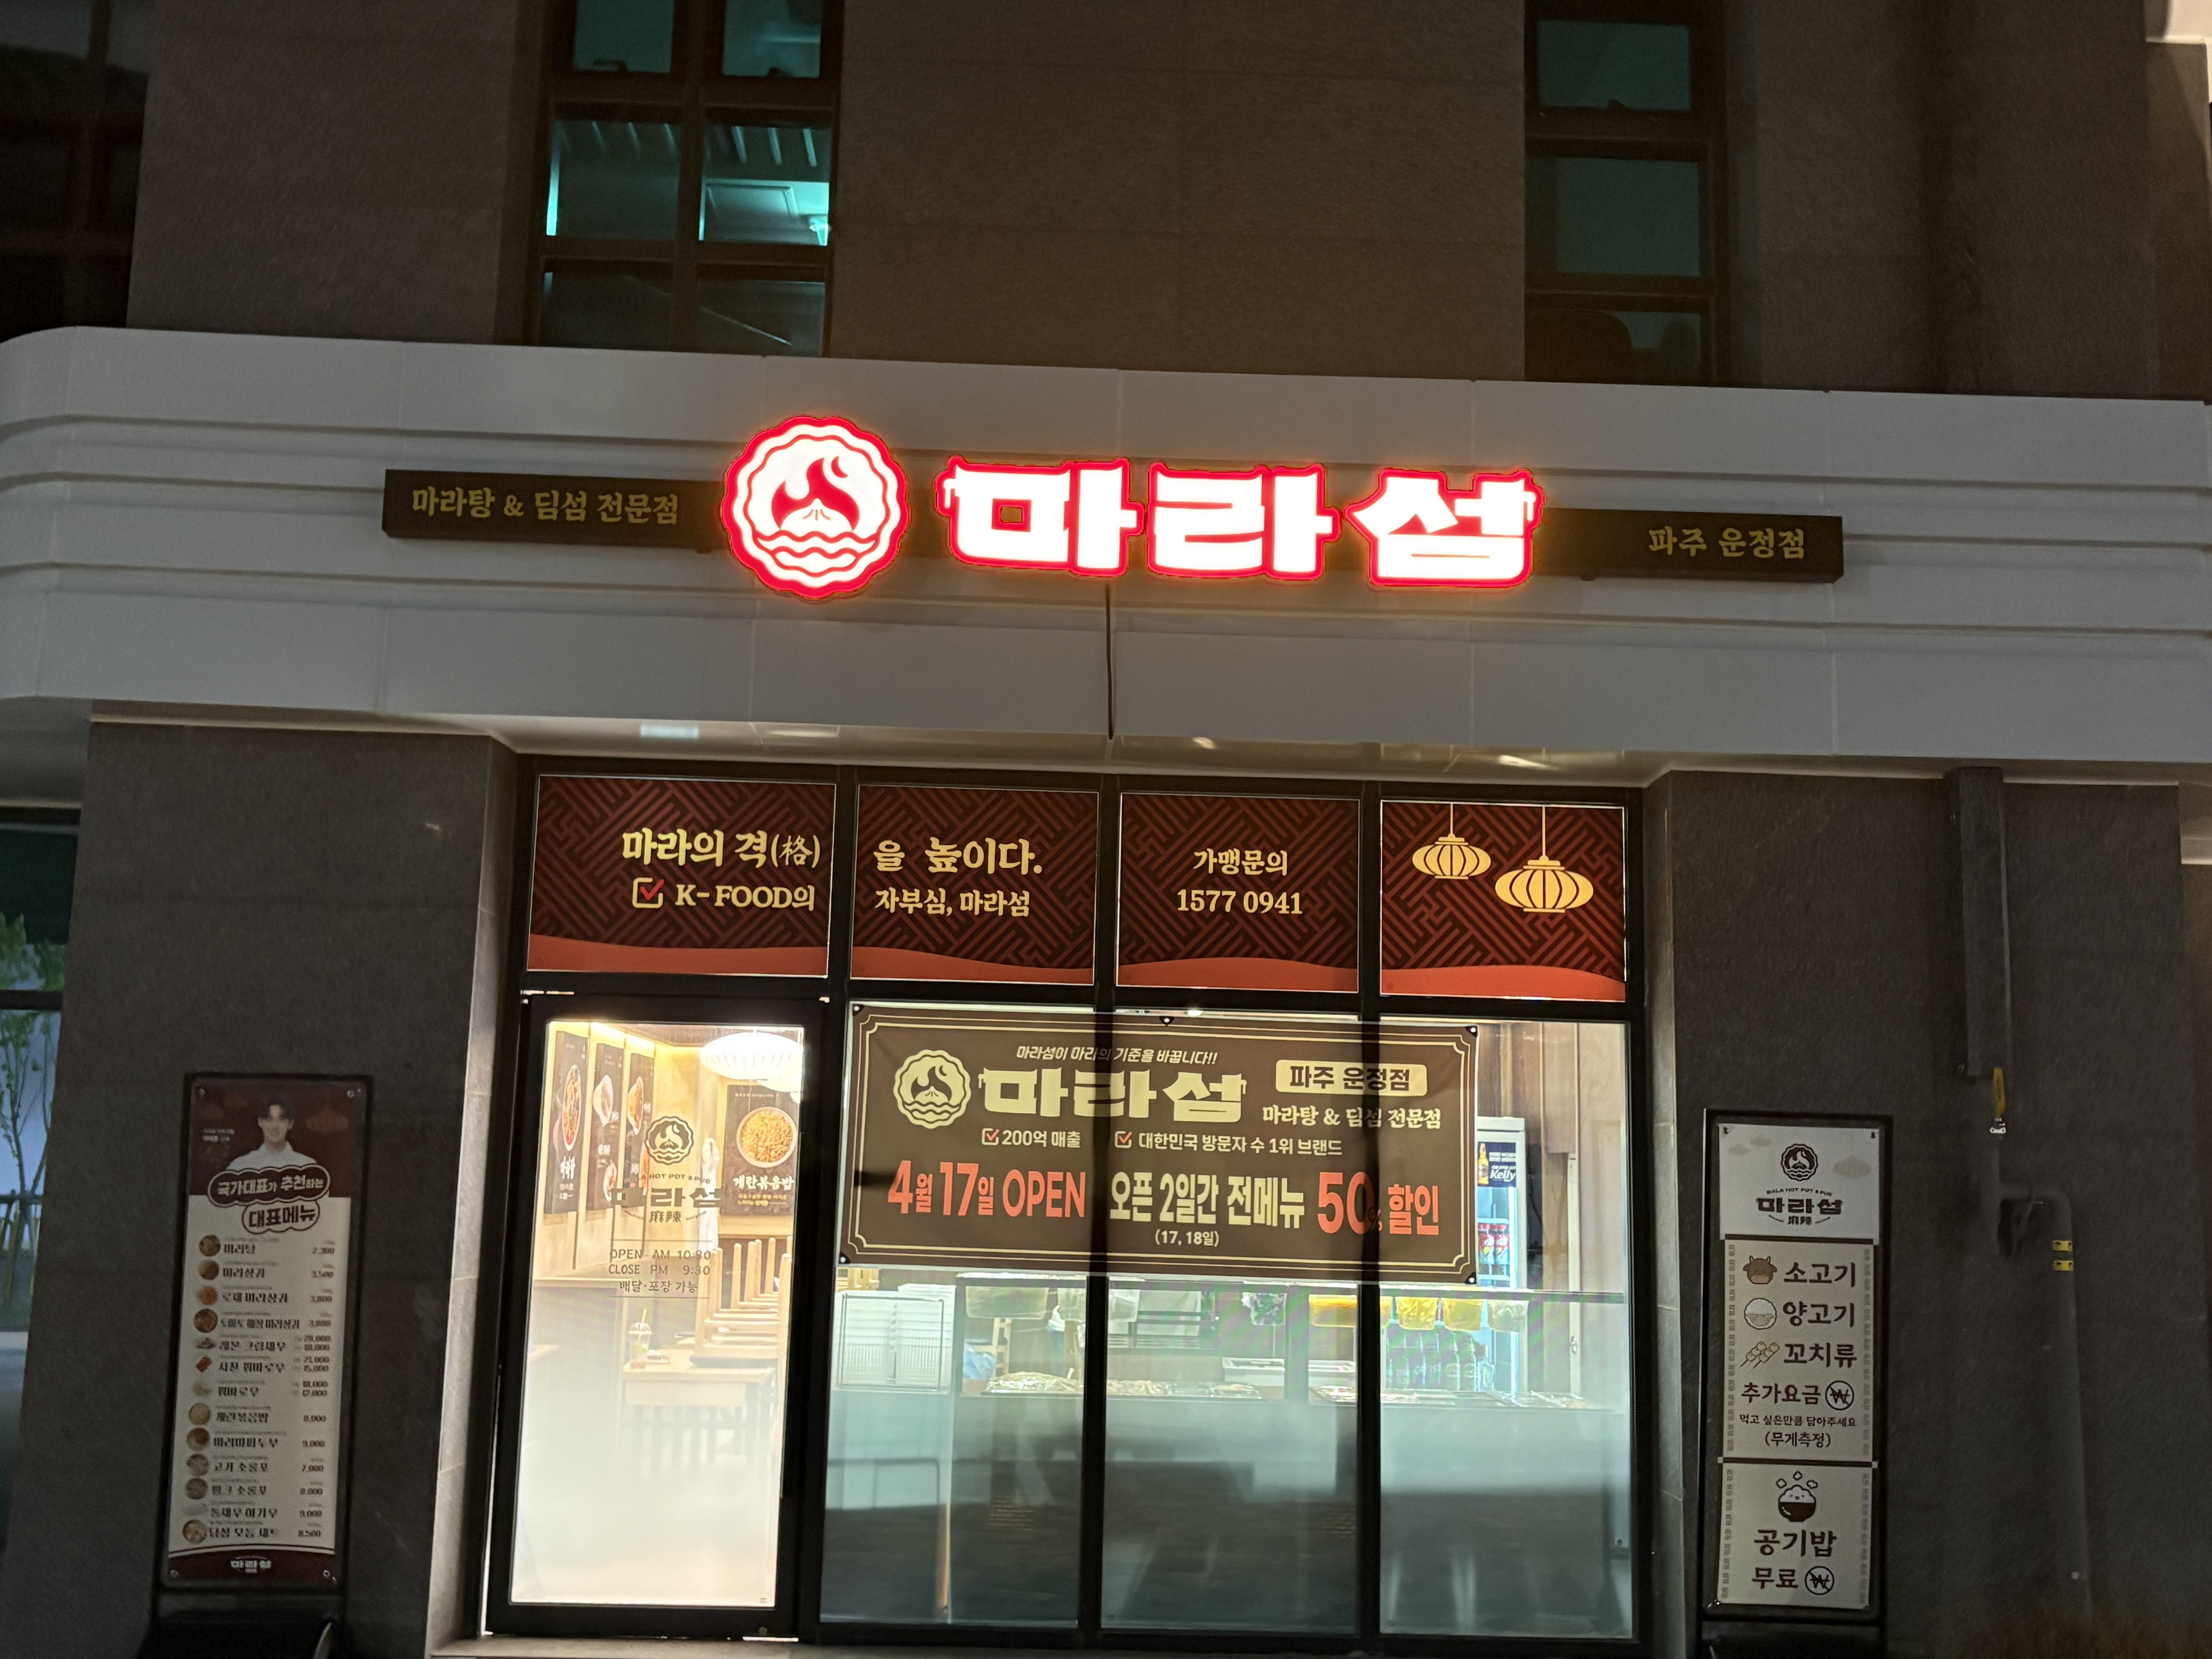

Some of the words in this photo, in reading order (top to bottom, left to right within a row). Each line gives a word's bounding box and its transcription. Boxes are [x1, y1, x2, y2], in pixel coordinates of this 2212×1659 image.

[412, 486, 495, 519] 마라탕
[503, 495, 524, 517] &
[534, 490, 587, 522] 딤섬
[597, 492, 678, 525] 전문점
[941, 457, 1540, 583] 마라섬
[1649, 526, 1707, 557] 파주
[1718, 527, 1805, 559] 운정점
[622, 827, 724, 867] 마라의
[734, 830, 820, 868] 격(格)
[873, 840, 905, 872] 을
[924, 836, 1042, 875] 높이다.
[1193, 848, 1288, 876] 가맹문의
[874, 887, 953, 917] 자부심,
[959, 889, 1030, 917] 마라섬
[1177, 889, 1236, 912] 1577
[1243, 891, 1303, 914] 0941
[1016, 1046, 1068, 1061] 마라섬이
[1070, 1046, 1112, 1061] 마라의
[1113, 1048, 1154, 1062] 기준을
[1156, 1051, 1218, 1065] 바꿉니다!!
[1290, 1065, 1334, 1089] 파주
[1343, 1067, 1410, 1092] 운정점
[978, 1067, 1247, 1122] 마라섬
[1262, 1104, 1319, 1126] 마라탕
[1323, 1108, 1341, 1126] &
[1345, 1107, 1382, 1128] 딤섬
[1388, 1107, 1441, 1129] 전문점
[1001, 1129, 1047, 1147] 200억
[1051, 1131, 1081, 1148] 매출
[1138, 1132, 1198, 1151] 대한민국
[1202, 1134, 1247, 1152] 방문자
[1250, 1137, 1265, 1154] 수
[1269, 1138, 1293, 1154] 1위
[1297, 1139, 1343, 1156] 브랜드
[218, 1178, 276, 1197] 국가대표가
[280, 1174, 324, 1191] 추천하는
[733, 1174, 795, 1191] 계란볶음밥
[1490, 1169, 1516, 1182] Kelly
[887, 1160, 933, 1214] 4월
[939, 1162, 994, 1216] 17일
[1002, 1169, 1086, 1218] OPEN
[1109, 1171, 1153, 1222] 오픈
[1159, 1173, 1219, 1224] 2일간
[1227, 1176, 1305, 1229] 전메뉴
[1388, 1183, 1439, 1236] 할인
[1756, 1197, 1843, 1215] 마라섬
[249, 1205, 315, 1228] 대표메뉴
[1155, 1228, 1182, 1246] (17,
[1186, 1230, 1219, 1247] 18일)
[611, 1249, 642, 1259] OPEN
[652, 1249, 670, 1259] AM
[677, 1250, 711, 1260] 10:30
[608, 1264, 641, 1274] CLOSE
[650, 1265, 668, 1275] PM
[683, 1265, 710, 1276] 9:30
[1783, 1262, 1856, 1287] 소고기
[675, 1281, 698, 1294] 가능
[1783, 1301, 1855, 1328] 양고기
[1783, 1342, 1857, 1369] 꼬치류
[1741, 1382, 1822, 1405] 추가요금
[1740, 1414, 1760, 1424] 먹고
[1806, 1416, 1857, 1427] 담아주세요
[1765, 1431, 1831, 1448] (무게측정)
[1754, 1529, 1837, 1557] 공기밥
[1752, 1567, 1799, 1589] 무료
